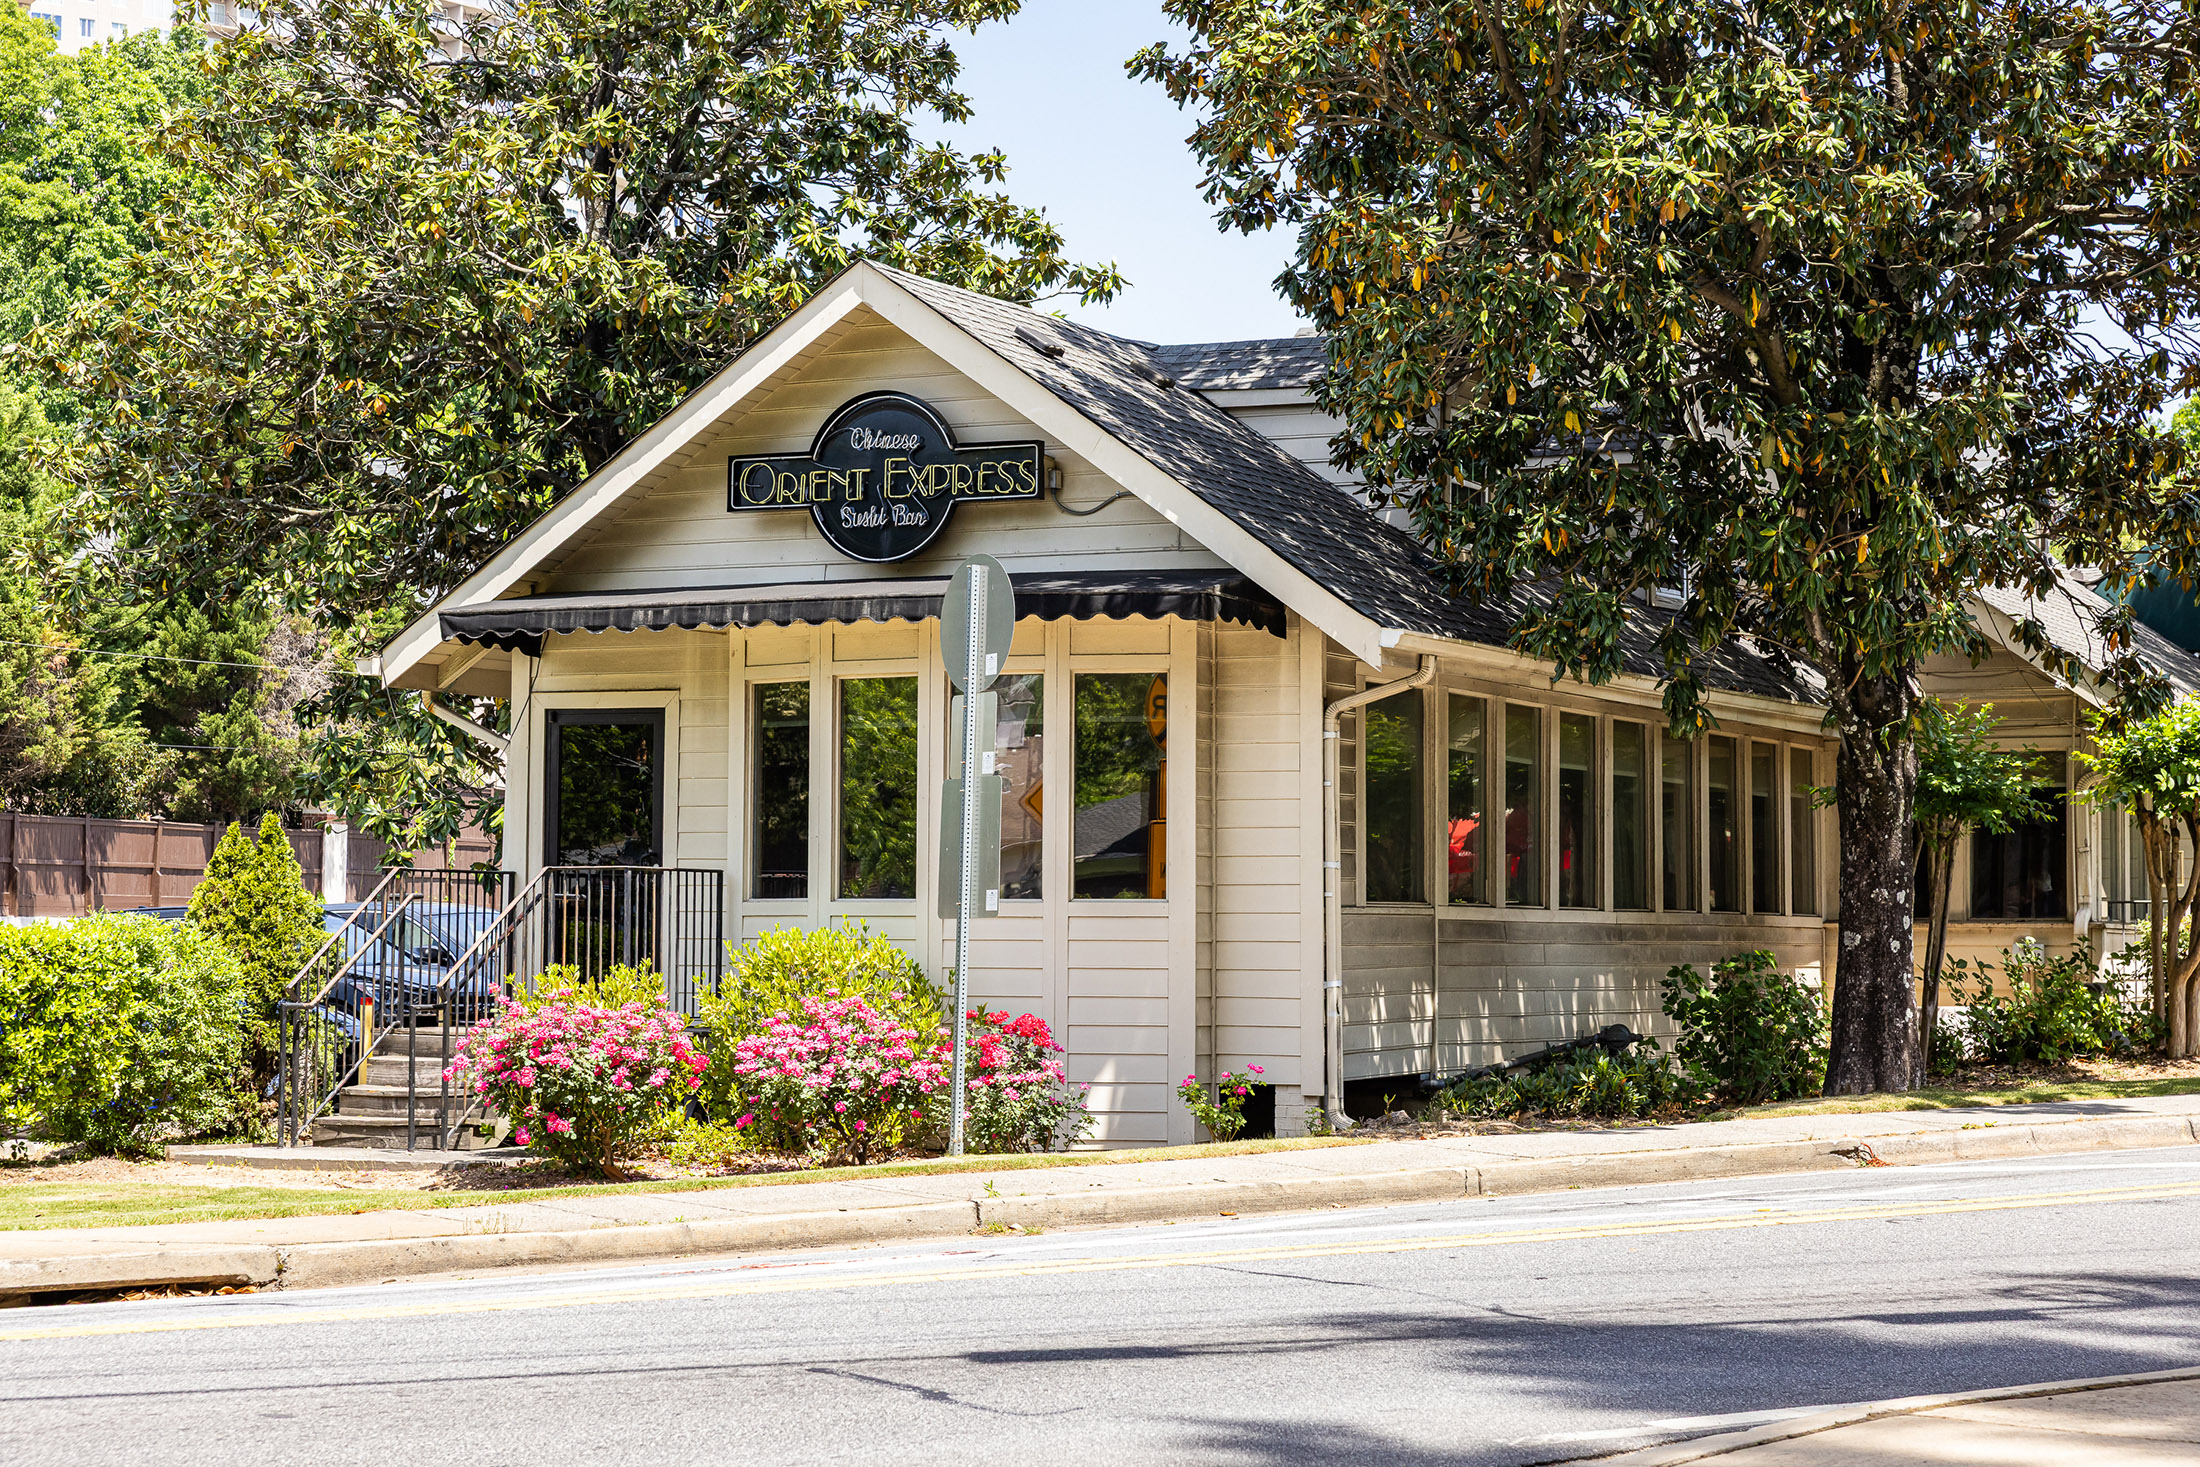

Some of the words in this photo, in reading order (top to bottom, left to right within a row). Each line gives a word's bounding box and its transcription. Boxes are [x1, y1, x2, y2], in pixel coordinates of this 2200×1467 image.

[851, 427, 920, 450] Chinese
[740, 462, 871, 504] ORIENT
[884, 457, 1036, 497] EXPRESS
[842, 505, 888, 528] Sushi
[893, 504, 928, 527] Bar
